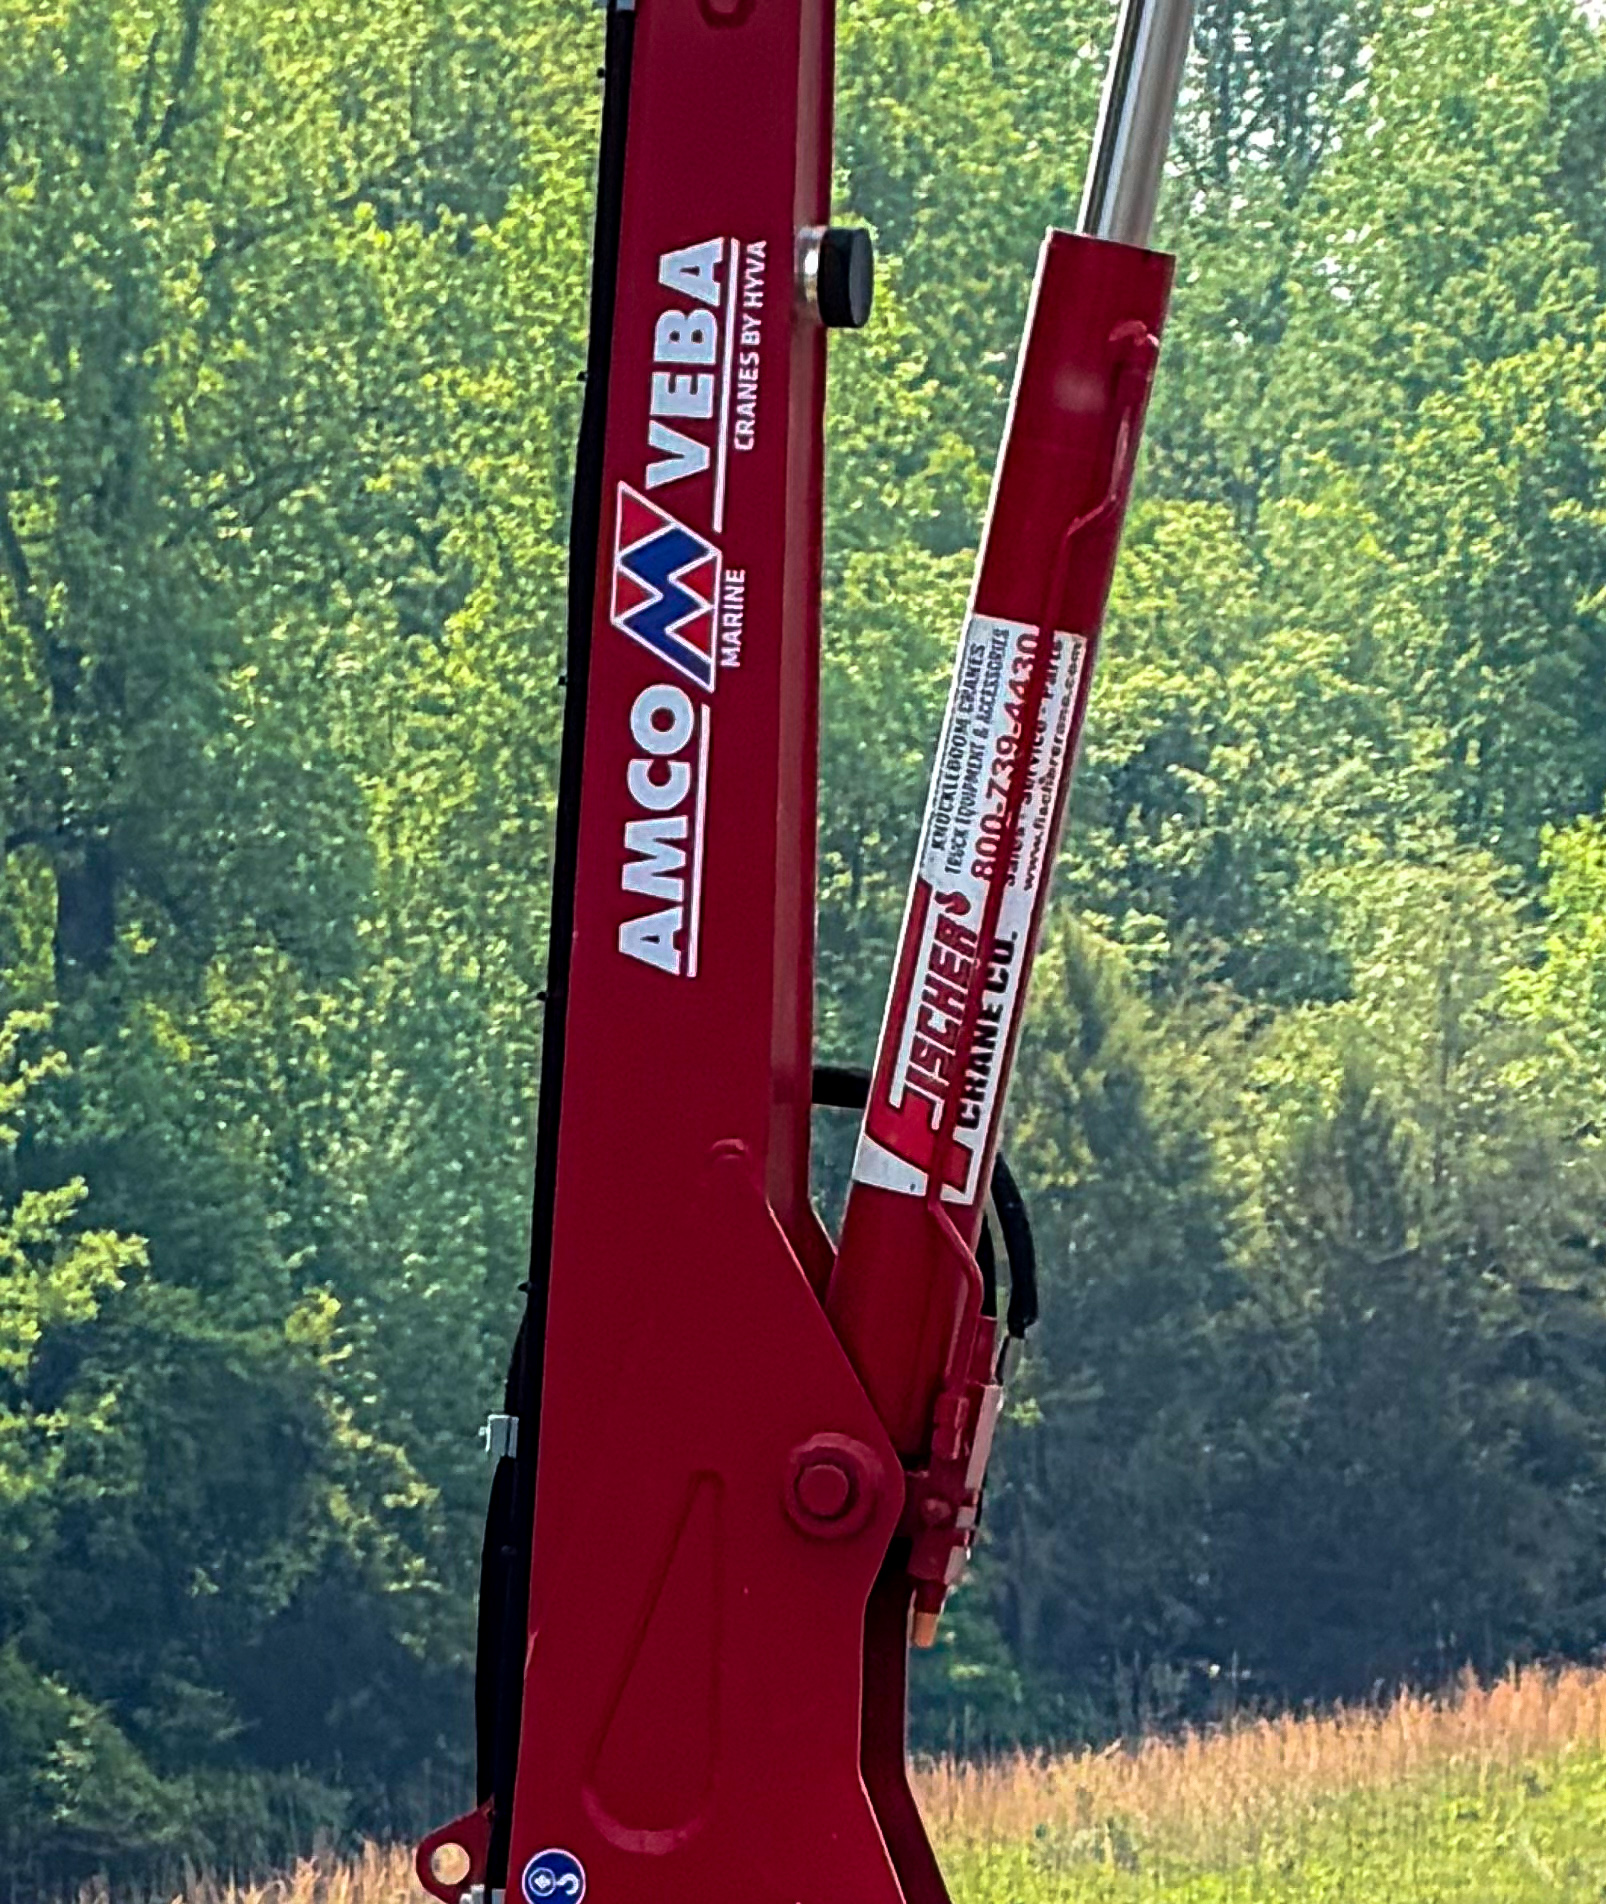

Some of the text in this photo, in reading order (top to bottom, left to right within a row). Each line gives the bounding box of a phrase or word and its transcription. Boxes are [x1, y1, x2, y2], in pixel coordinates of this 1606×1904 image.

[646, 236, 724, 490] VEBA
[734, 240, 768, 451] CRANES BY HYVA
[719, 568, 746, 668] MARINE
[958, 641, 986, 714] CRANES
[618, 683, 695, 977] AMCO
[955, 740, 986, 826] EQUIPMENT
[970, 630, 1041, 881] 800-739-4430
[956, 1002, 1004, 1131] CRANE
